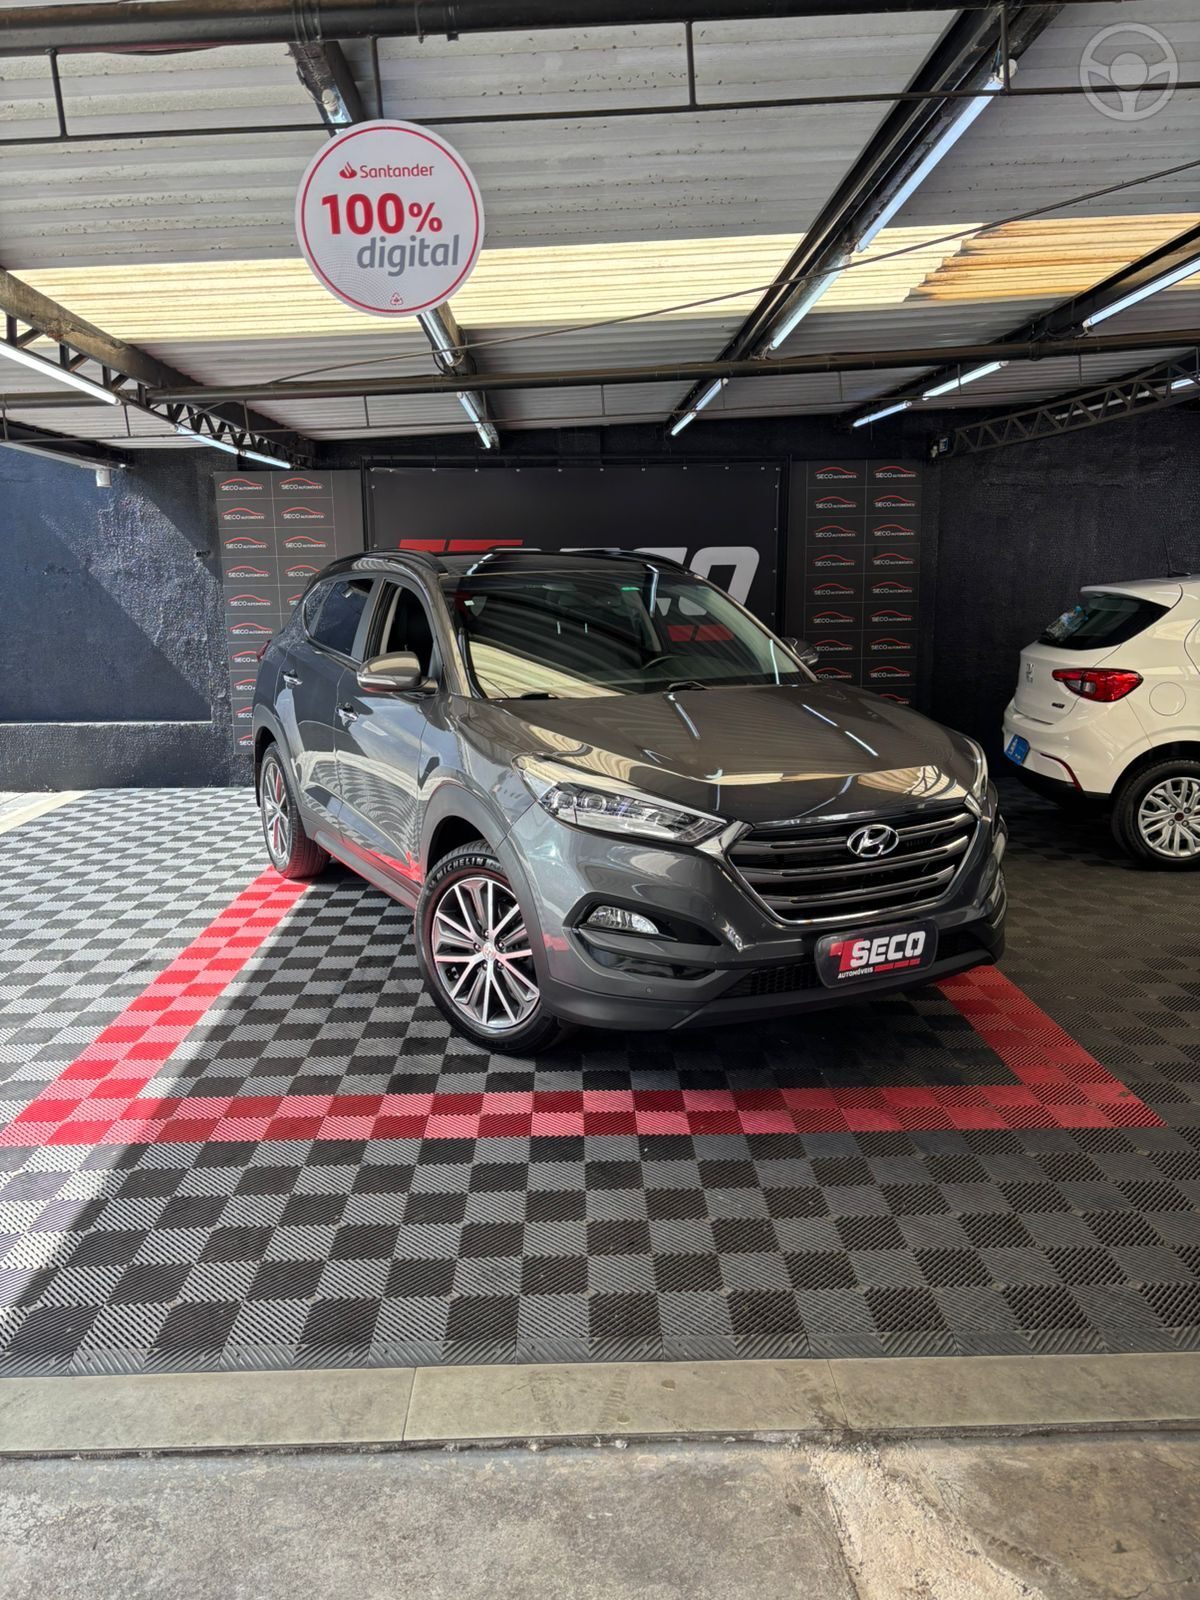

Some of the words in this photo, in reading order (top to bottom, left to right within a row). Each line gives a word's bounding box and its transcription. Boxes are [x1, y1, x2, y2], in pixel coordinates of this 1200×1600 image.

[359, 164, 435, 179] Santander
[321, 192, 443, 235] 100%
[356, 234, 460, 277] digital
[436, 857, 484, 880] MICHELIN
[837, 966, 874, 979] AUTOMÓVEIS
